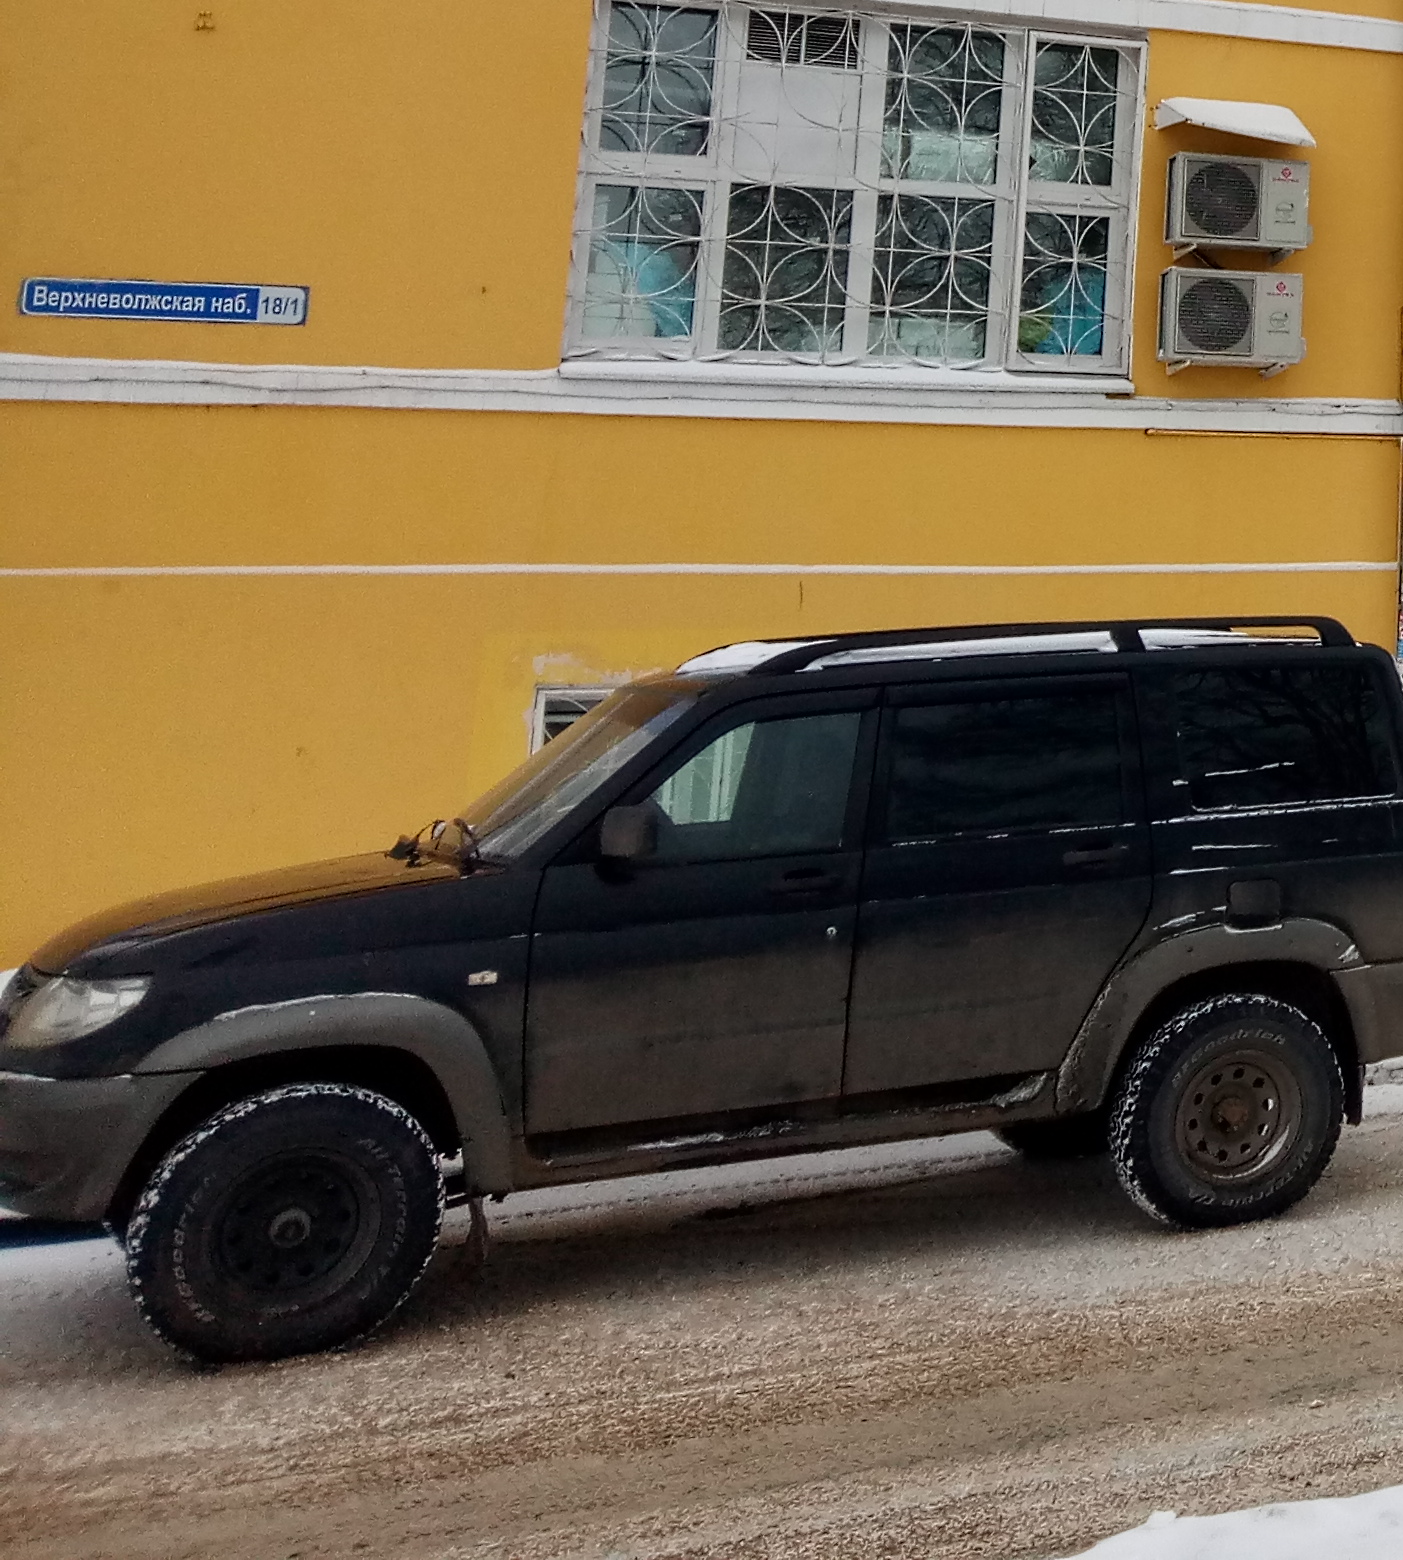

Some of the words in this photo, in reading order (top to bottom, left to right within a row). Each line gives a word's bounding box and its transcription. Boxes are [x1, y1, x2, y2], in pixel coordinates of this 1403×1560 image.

[33, 286, 205, 311] Верхневолжская
[211, 293, 251, 314] наб.
[261, 296, 300, 316] 18/1
